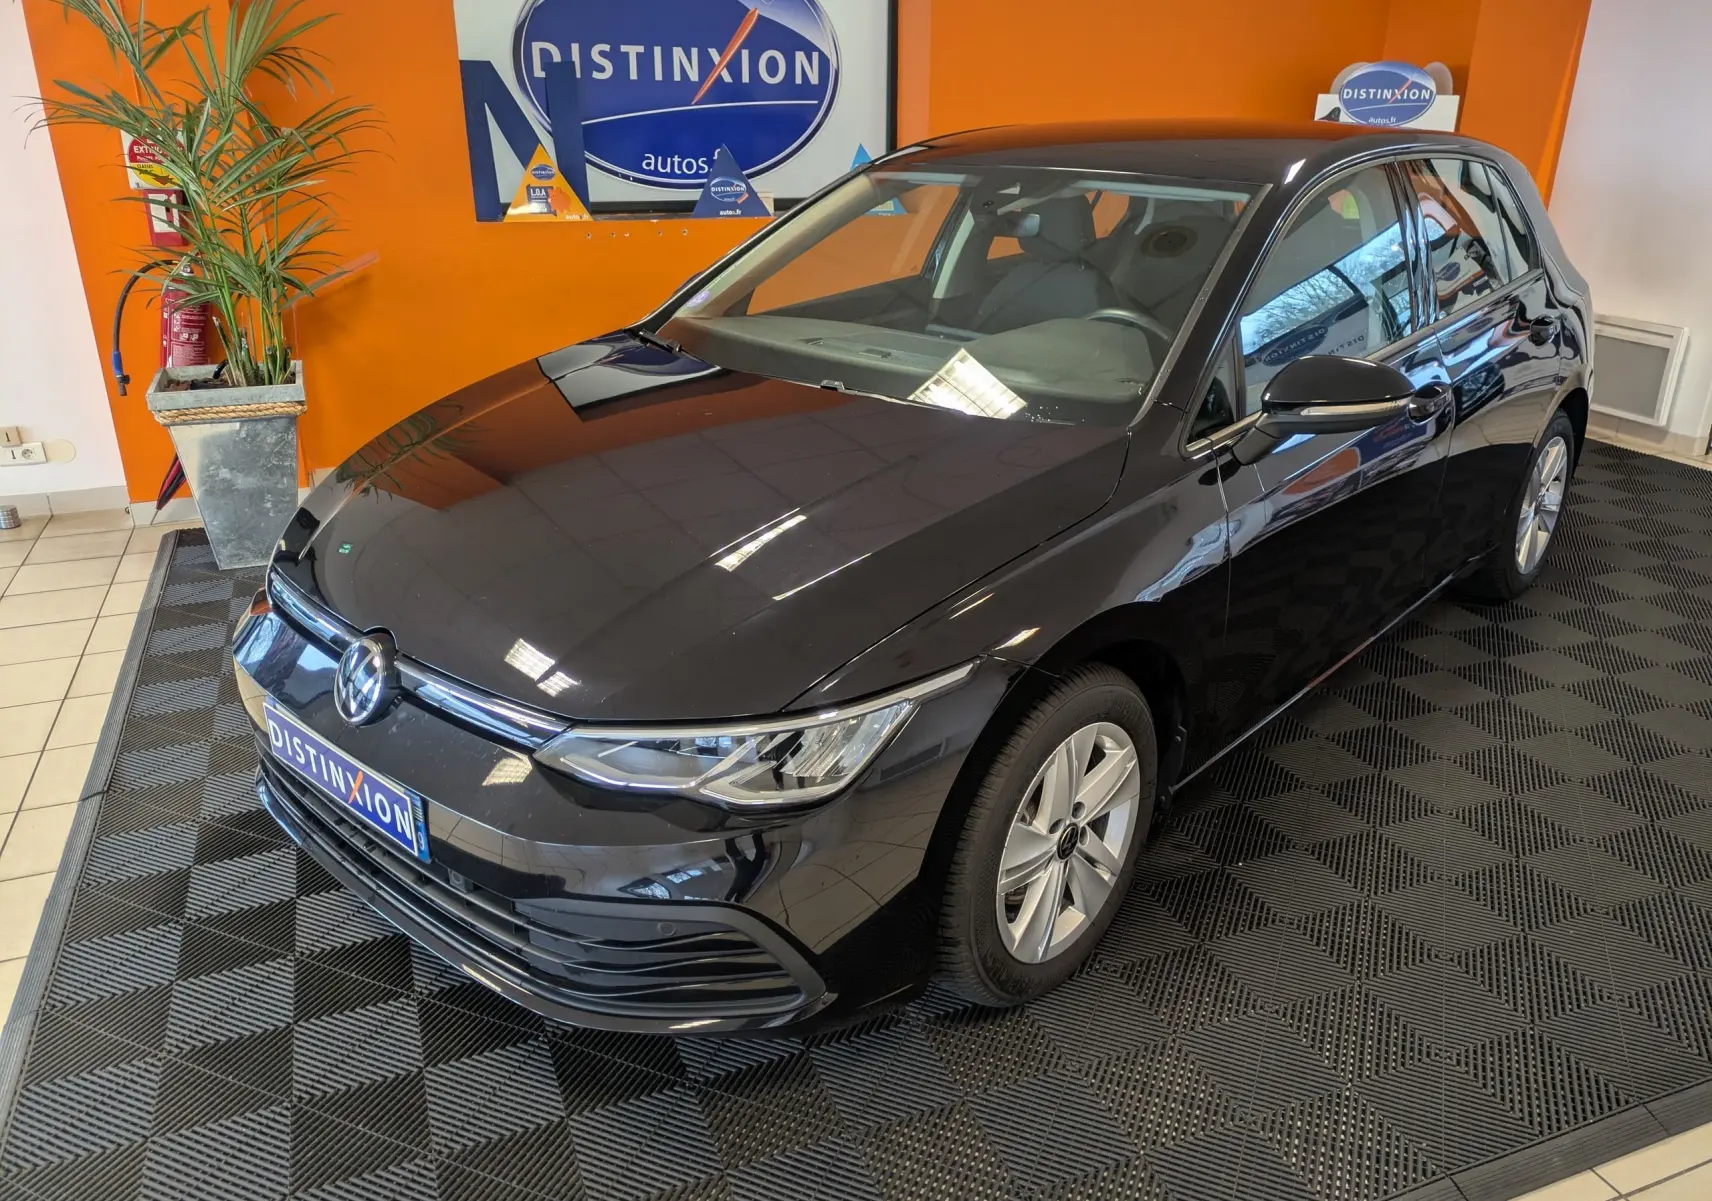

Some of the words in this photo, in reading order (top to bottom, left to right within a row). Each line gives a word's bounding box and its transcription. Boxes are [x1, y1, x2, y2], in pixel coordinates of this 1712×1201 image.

[531, 41, 820, 85] DISTINXION
[1343, 88, 1431, 99] DISTINXION
[1368, 116, 1397, 125] autos.fr
[267, 718, 412, 841] DISTINXION
